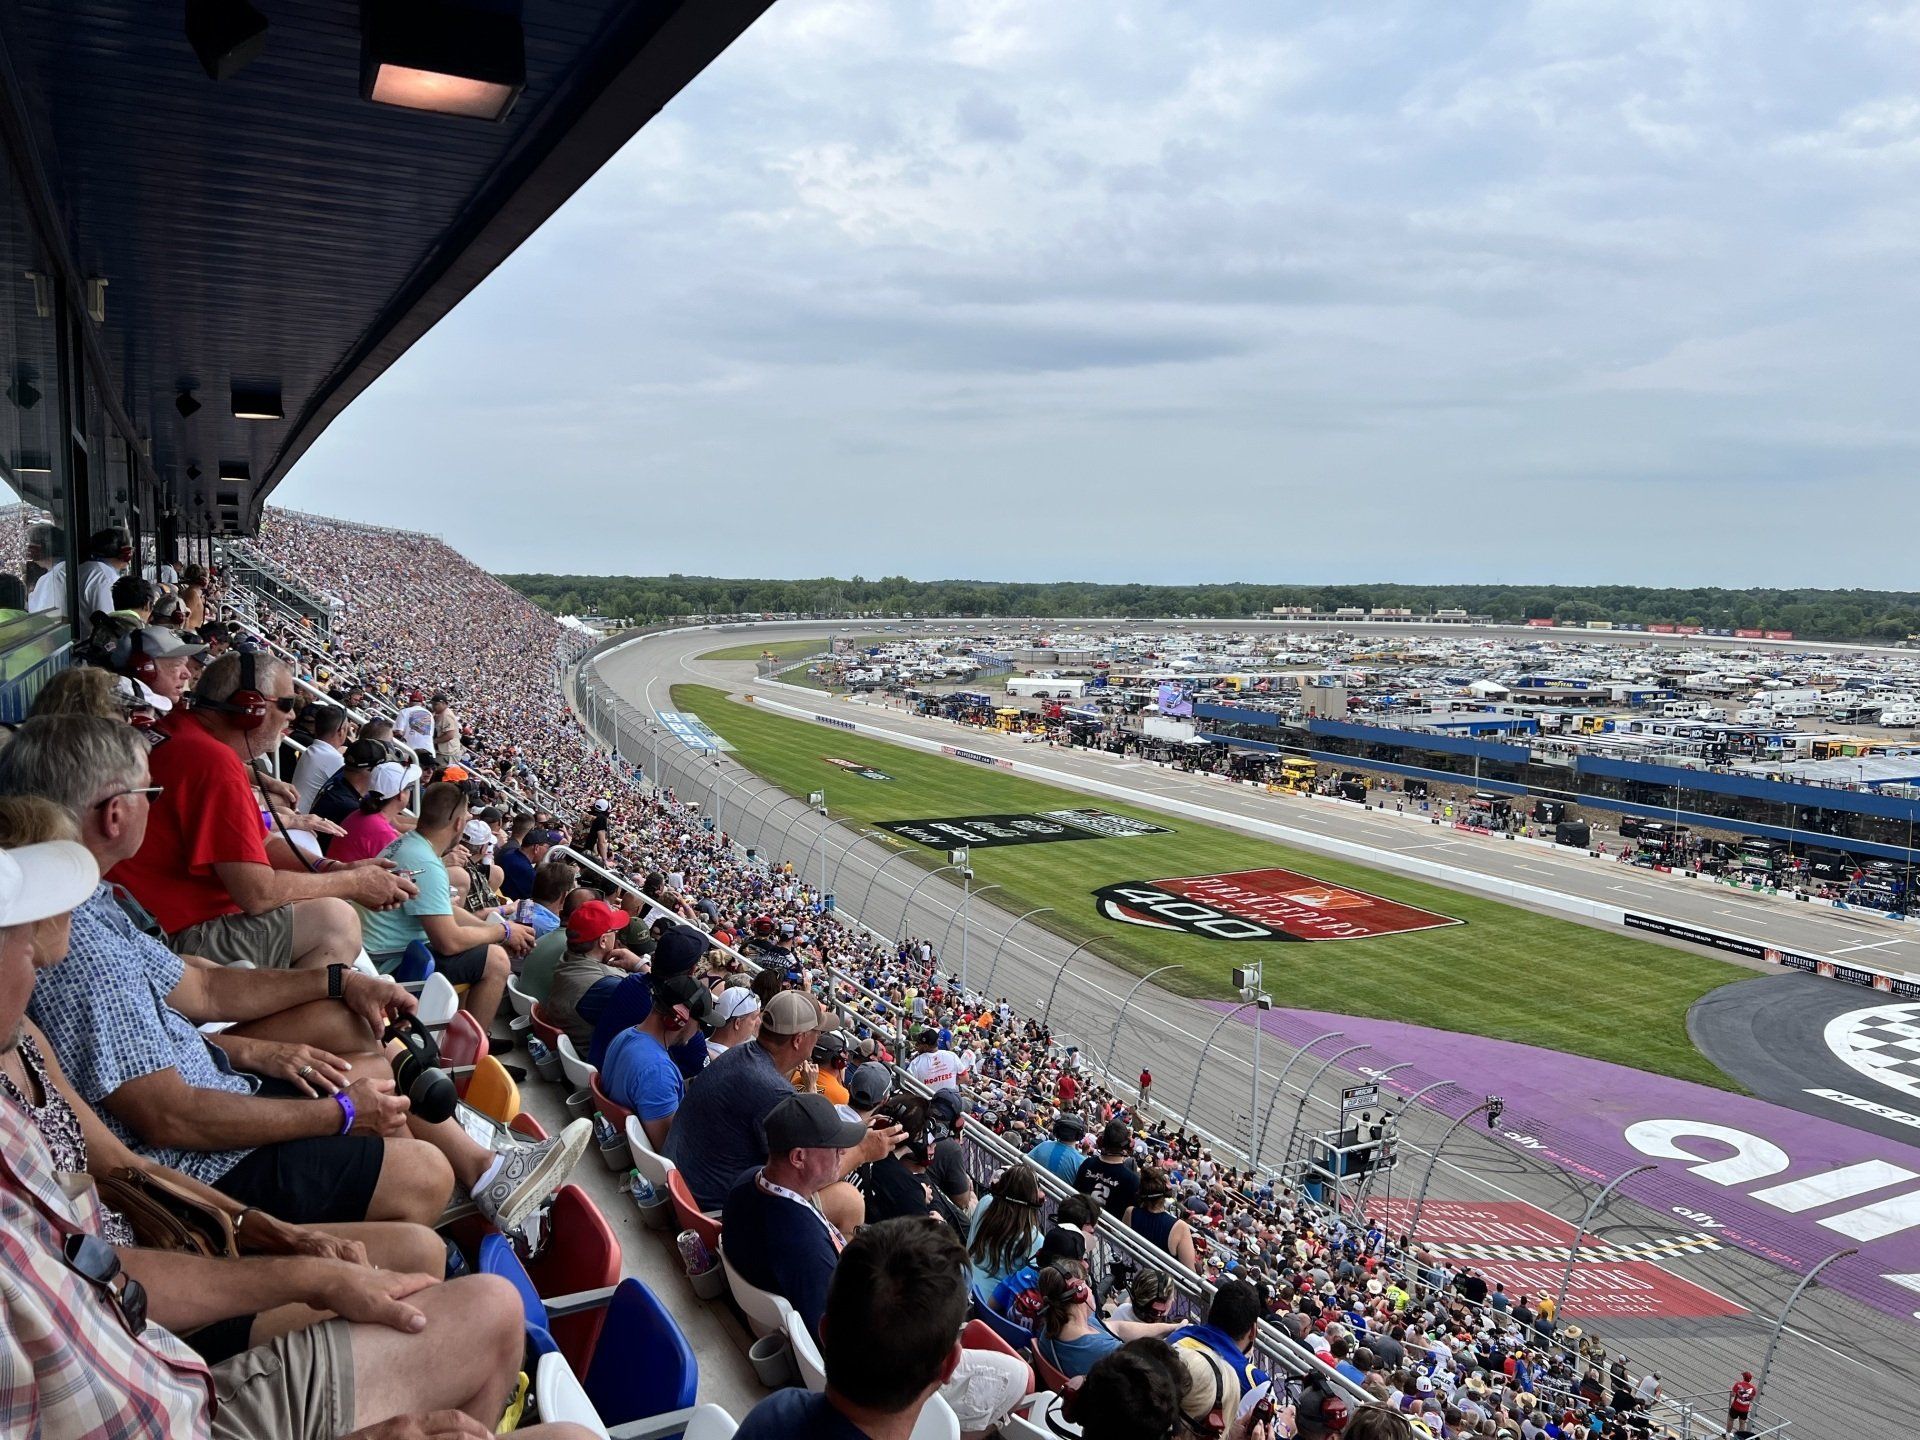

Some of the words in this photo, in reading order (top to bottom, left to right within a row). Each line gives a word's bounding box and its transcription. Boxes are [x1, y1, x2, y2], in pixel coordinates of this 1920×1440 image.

[927, 822, 988, 842] GEICO
[1114, 888, 1272, 938] 400
[1183, 879, 1372, 938] FIREKEEPERS
[1183, 892, 1286, 927] CASINO
[1894, 981, 1920, 994] FIREKEEP
[924, 1072, 953, 1085] HOOTERS
[1826, 1094, 1920, 1126] MISP
[1503, 1131, 1548, 1149] ally
[1091, 1183, 1110, 1206] 2
[1671, 1206, 1727, 1229] ally
[1596, 1294, 1663, 1303] HOTEL
